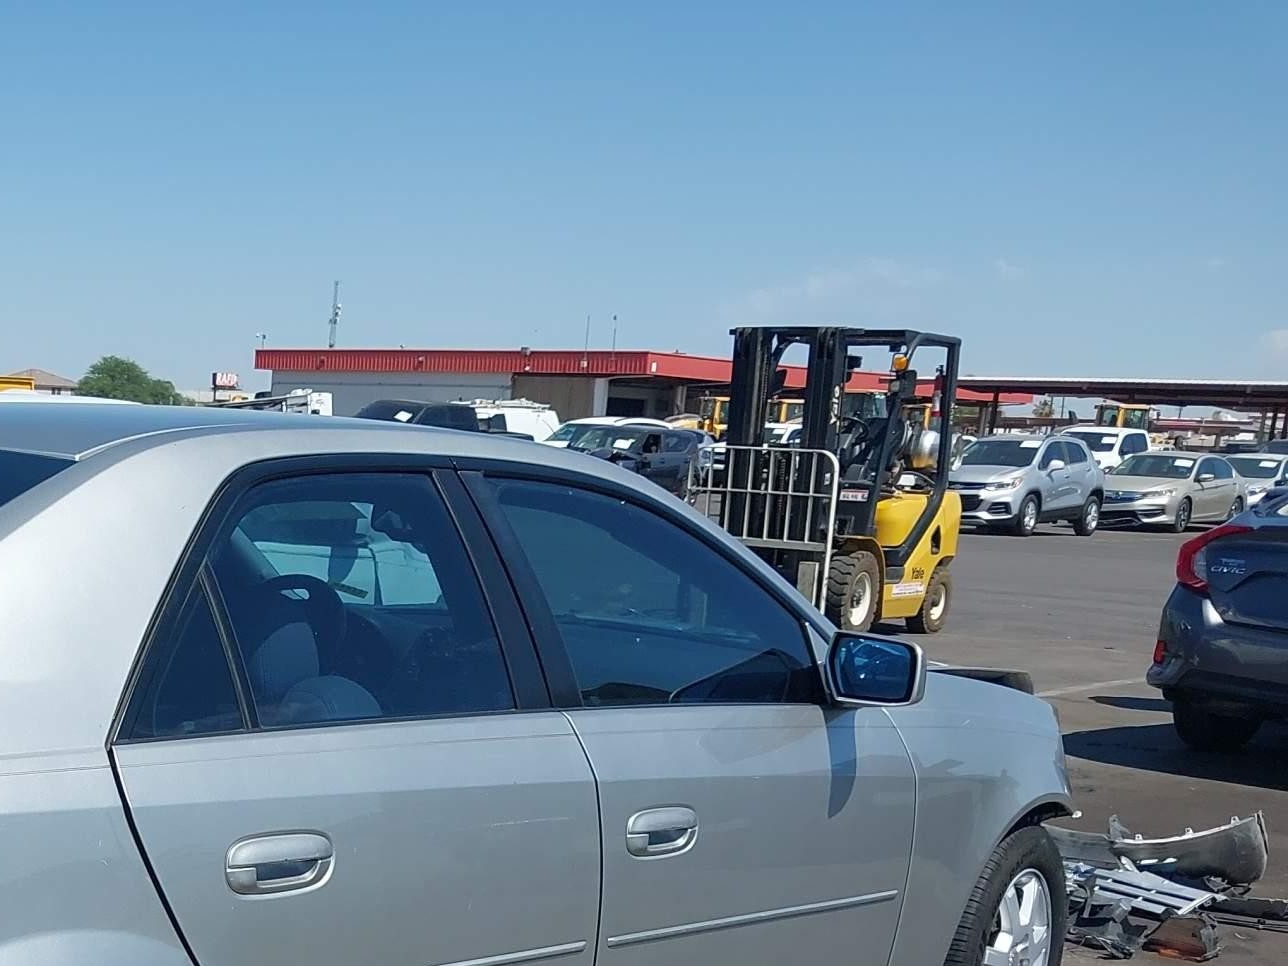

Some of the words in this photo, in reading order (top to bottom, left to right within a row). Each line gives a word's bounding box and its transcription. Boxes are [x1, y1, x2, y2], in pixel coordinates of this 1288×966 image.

[829, 385, 840, 433] Yale
[912, 567, 925, 580] Yale
[1210, 565, 1246, 574] CIVIC
